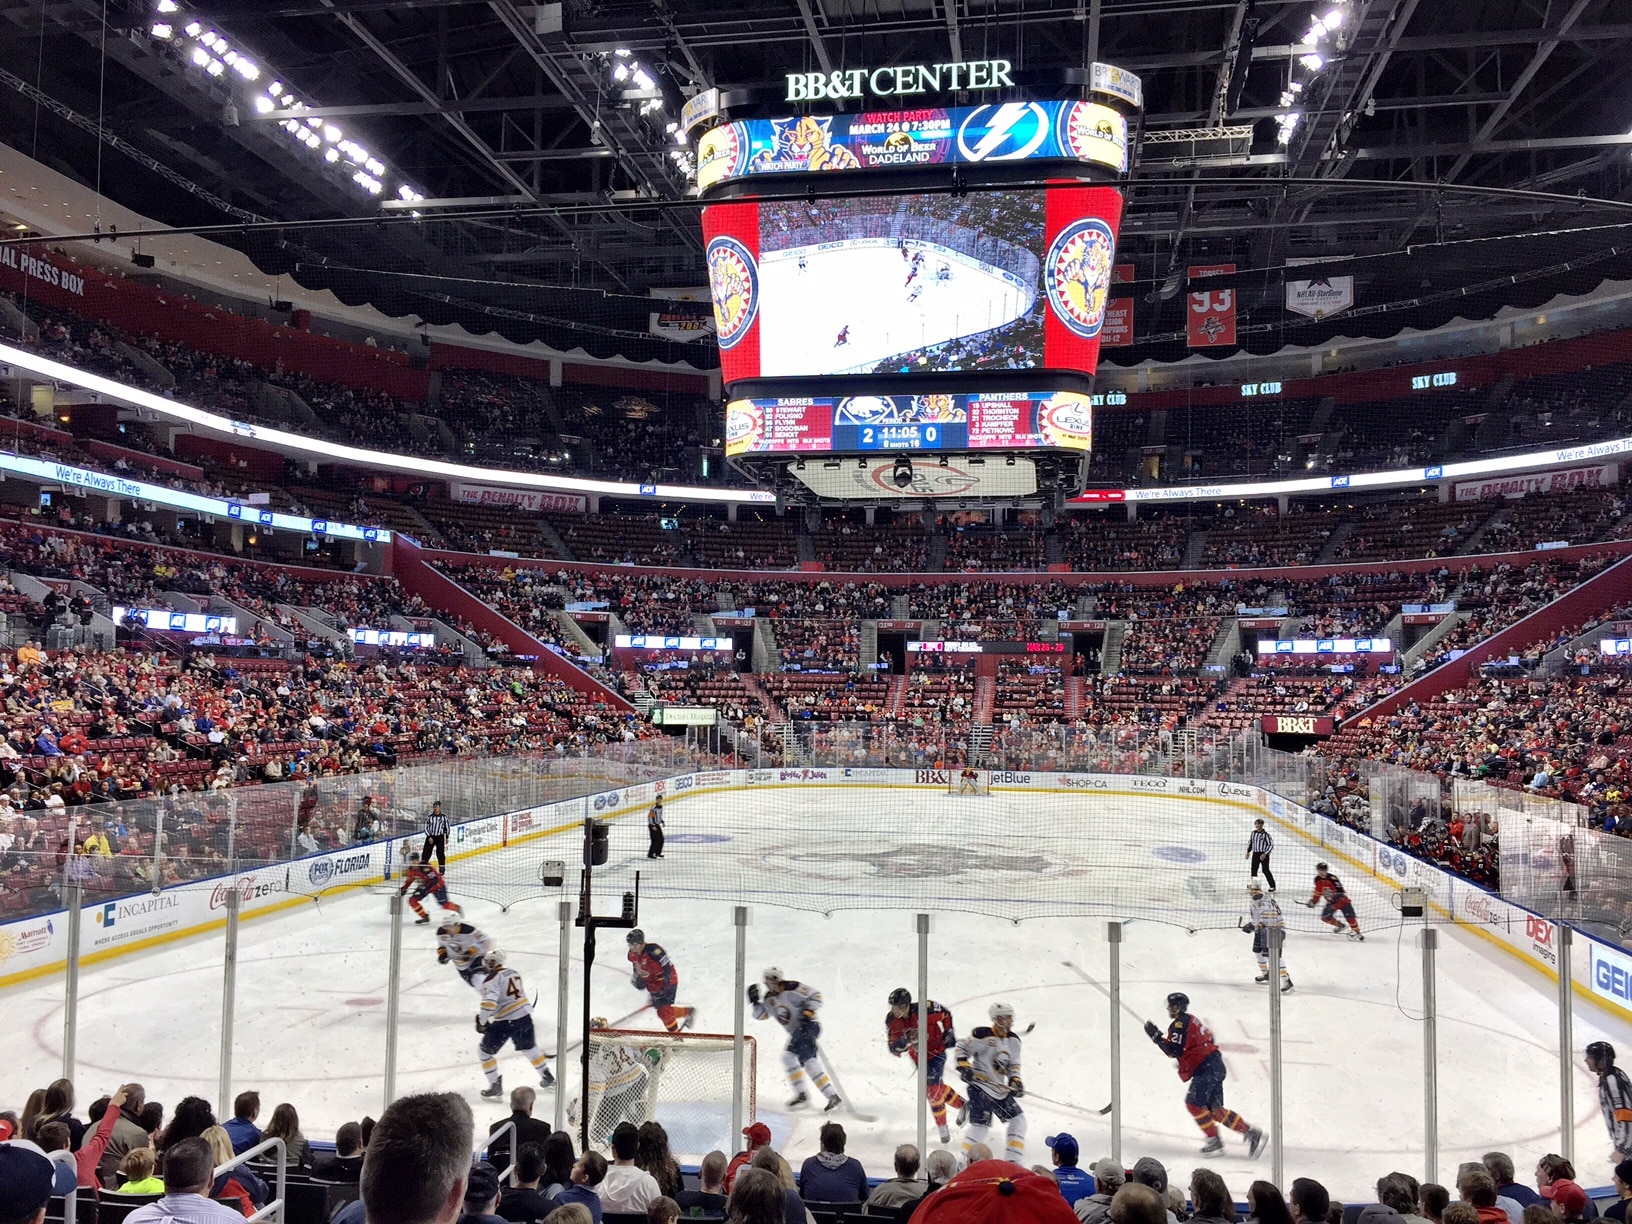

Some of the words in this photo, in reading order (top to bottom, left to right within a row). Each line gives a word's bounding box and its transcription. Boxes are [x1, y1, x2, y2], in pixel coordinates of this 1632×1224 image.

[785, 69, 868, 101] BB&T
[870, 60, 1015, 95] CENTER
[867, 112, 900, 123] WATCH
[904, 110, 933, 121] PARTY
[849, 123, 884, 135] MARCH
[887, 122, 900, 132] 24
[912, 119, 950, 131] 7:30PM
[869, 152, 929, 164] DADELAND
[760, 162, 782, 170] WATCH
[818, 242, 843, 250] GEICO
[21, 254, 59, 285] PRESS
[61, 271, 84, 296] BOX
[1191, 290, 1232, 312] 93
[1412, 375, 1430, 390] SKY
[1432, 371, 1457, 387] CLUB
[1241, 384, 1257, 396] SKY
[1260, 381, 1282, 394] CLUB
[778, 398, 814, 406] SABRES
[980, 393, 1028, 401] PANTHERS
[1107, 393, 1127, 405] CLUB
[862, 428, 874, 443] 2
[882, 427, 917, 439] 11:05
[925, 426, 937, 442] 0
[883, 440, 889, 448] 8
[910, 439, 919, 448] 16
[1557, 449, 1584, 460] We're
[1587, 444, 1620, 457] Always
[56, 465, 82, 483] We're
[83, 472, 115, 491] Always
[117, 479, 141, 495] There
[1460, 487, 1478, 498] THE
[1550, 468, 1604, 493] BOX
[462, 490, 479, 499] THE
[750, 492, 773, 501] We're
[1135, 490, 1160, 499] We're
[1163, 487, 1194, 498] Always
[1196, 487, 1221, 496] There
[665, 711, 689, 721] Doctors
[691, 709, 716, 722] Hospital
[1277, 717, 1318, 733] BB&T
[676, 776, 692, 790] GEICO
[990, 771, 1031, 785] jetBlue
[1131, 779, 1166, 787] TECO
[1229, 787, 1251, 797] LEXUS
[314, 861, 329, 875] FOX
[335, 853, 370, 875] FLORIDA
[255, 880, 282, 898] zero
[118, 895, 179, 919] INCAPITAL
[18, 927, 47, 941] Marriott
[94, 936, 110, 945] WHERE
[112, 932, 128, 942] ACCESS
[130, 927, 147, 938] EQUALS
[148, 920, 178, 934] OPPORTUNITY
[1526, 914, 1554, 945] DEX
[1532, 943, 1556, 964] imaging
[506, 975, 522, 1000] 47
[1171, 1032, 1183, 1044] 21
